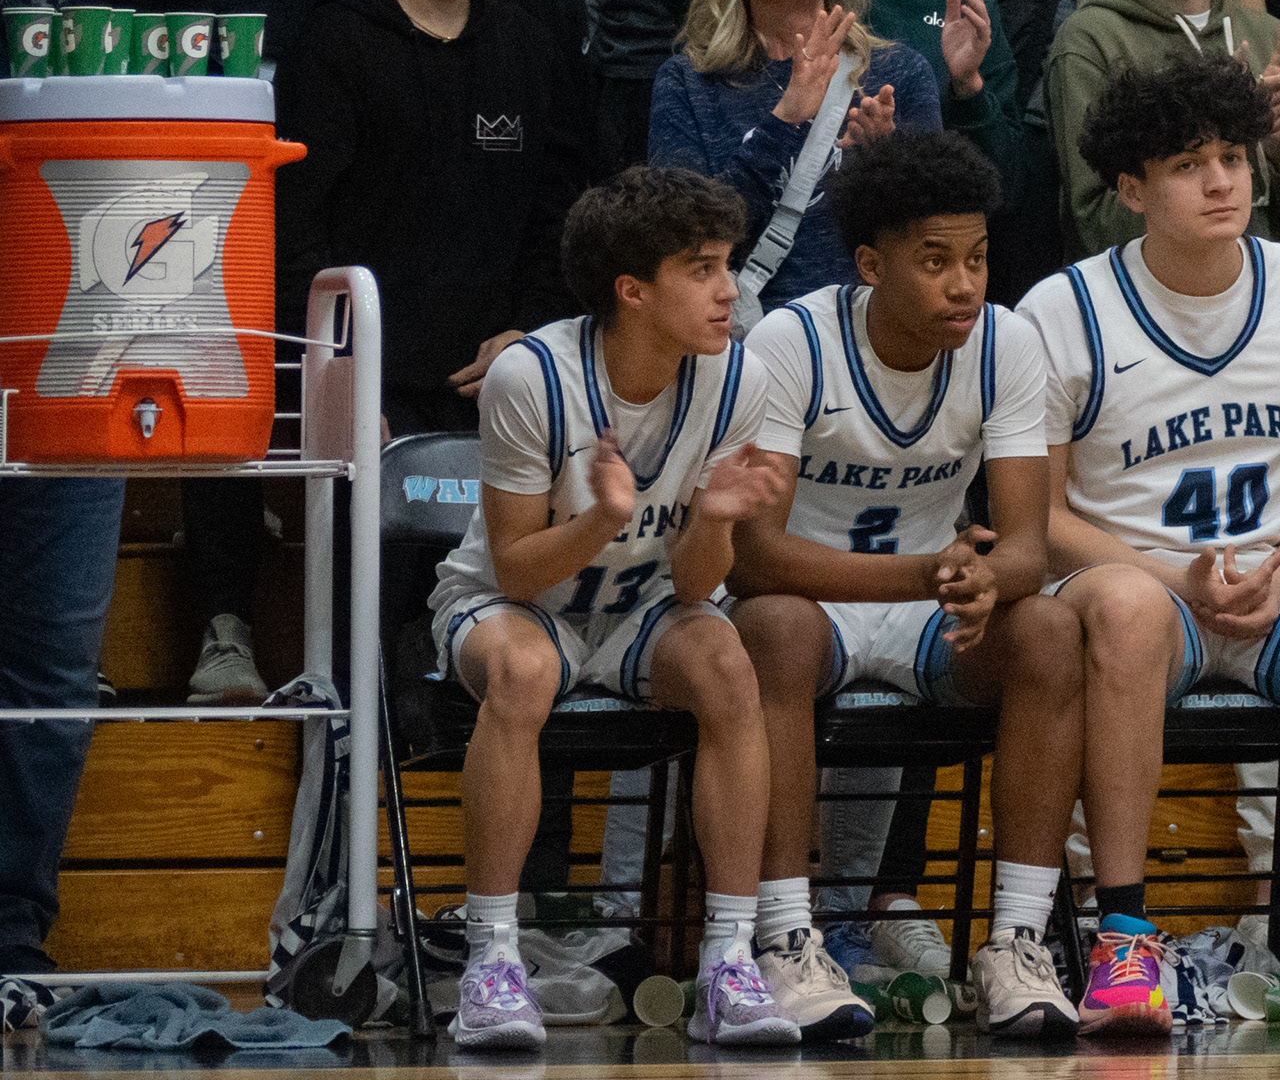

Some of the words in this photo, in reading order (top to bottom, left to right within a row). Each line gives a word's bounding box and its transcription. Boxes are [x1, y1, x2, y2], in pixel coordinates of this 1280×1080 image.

[181, 25, 210, 59] G
[1121, 406, 1213, 470] LAKE
[797, 455, 892, 490] LAKE
[1161, 462, 1271, 543] 40
[849, 505, 901, 555] 2
[557, 559, 661, 618] 13
